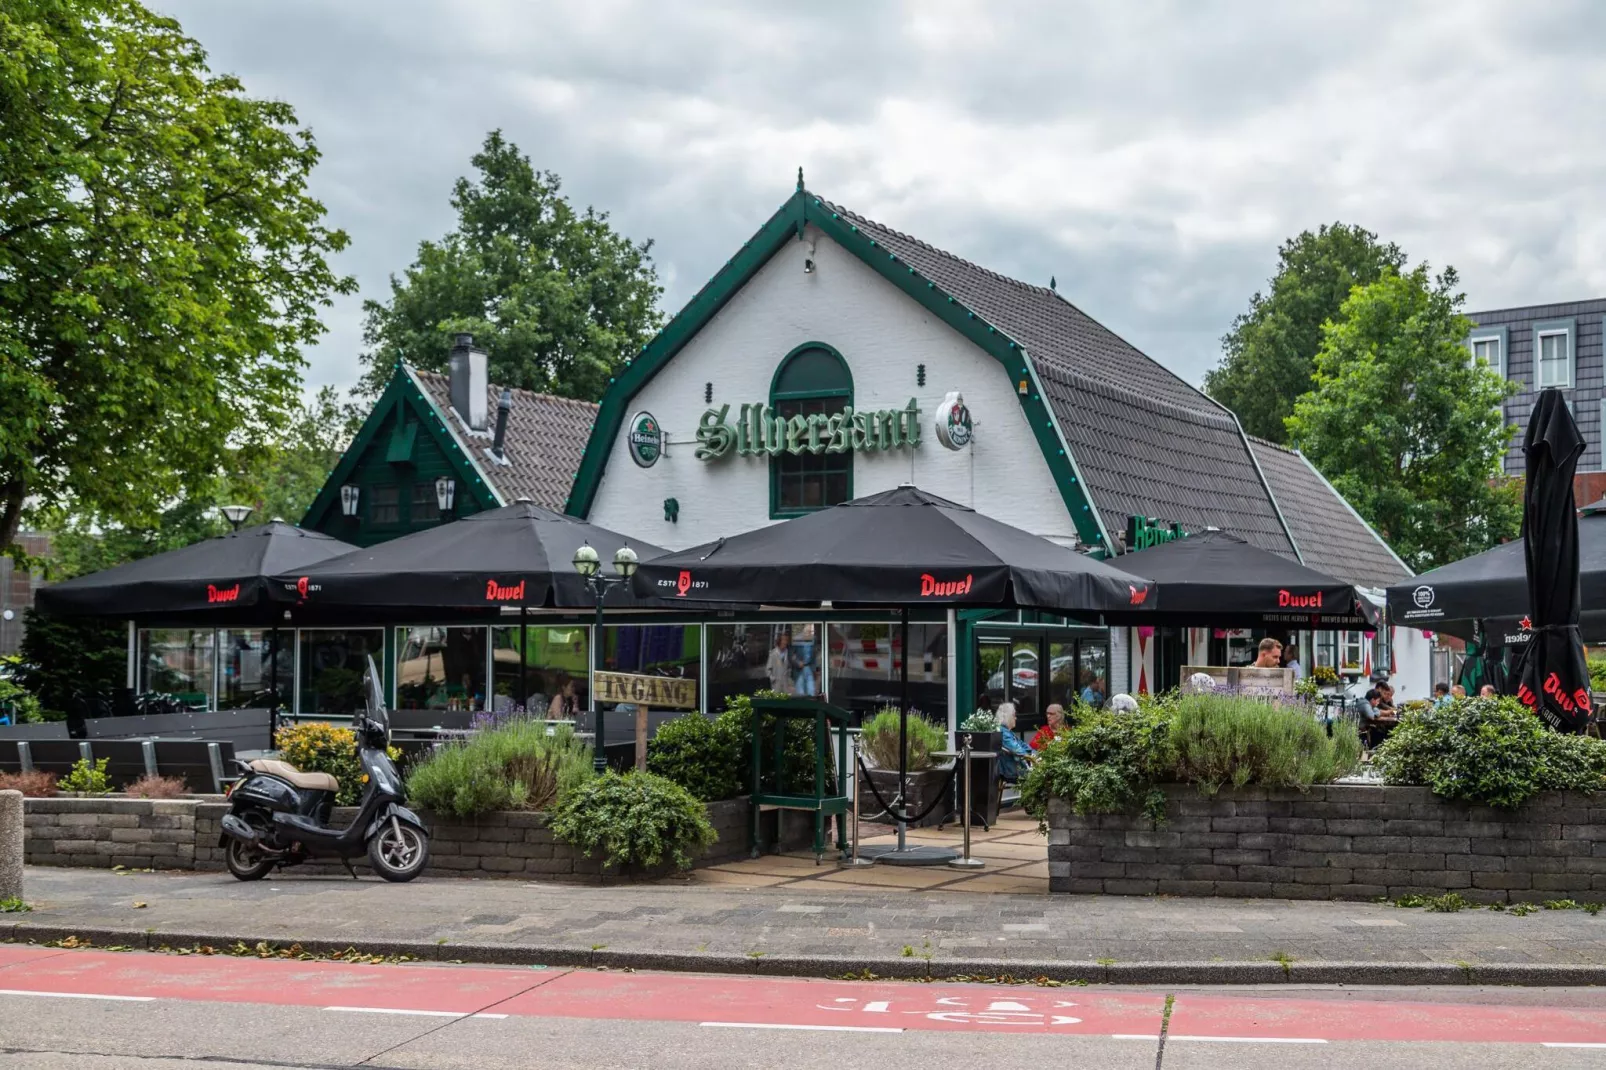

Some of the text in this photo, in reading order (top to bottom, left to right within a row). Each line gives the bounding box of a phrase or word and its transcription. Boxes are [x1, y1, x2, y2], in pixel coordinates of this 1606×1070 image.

[695, 397, 922, 461] Silversant
[207, 583, 240, 602] Duvel
[486, 579, 525, 600] Duvel
[921, 573, 972, 596] Duvel
[1279, 589, 1323, 607] Duvel
[604, 675, 689, 704] INGANG
